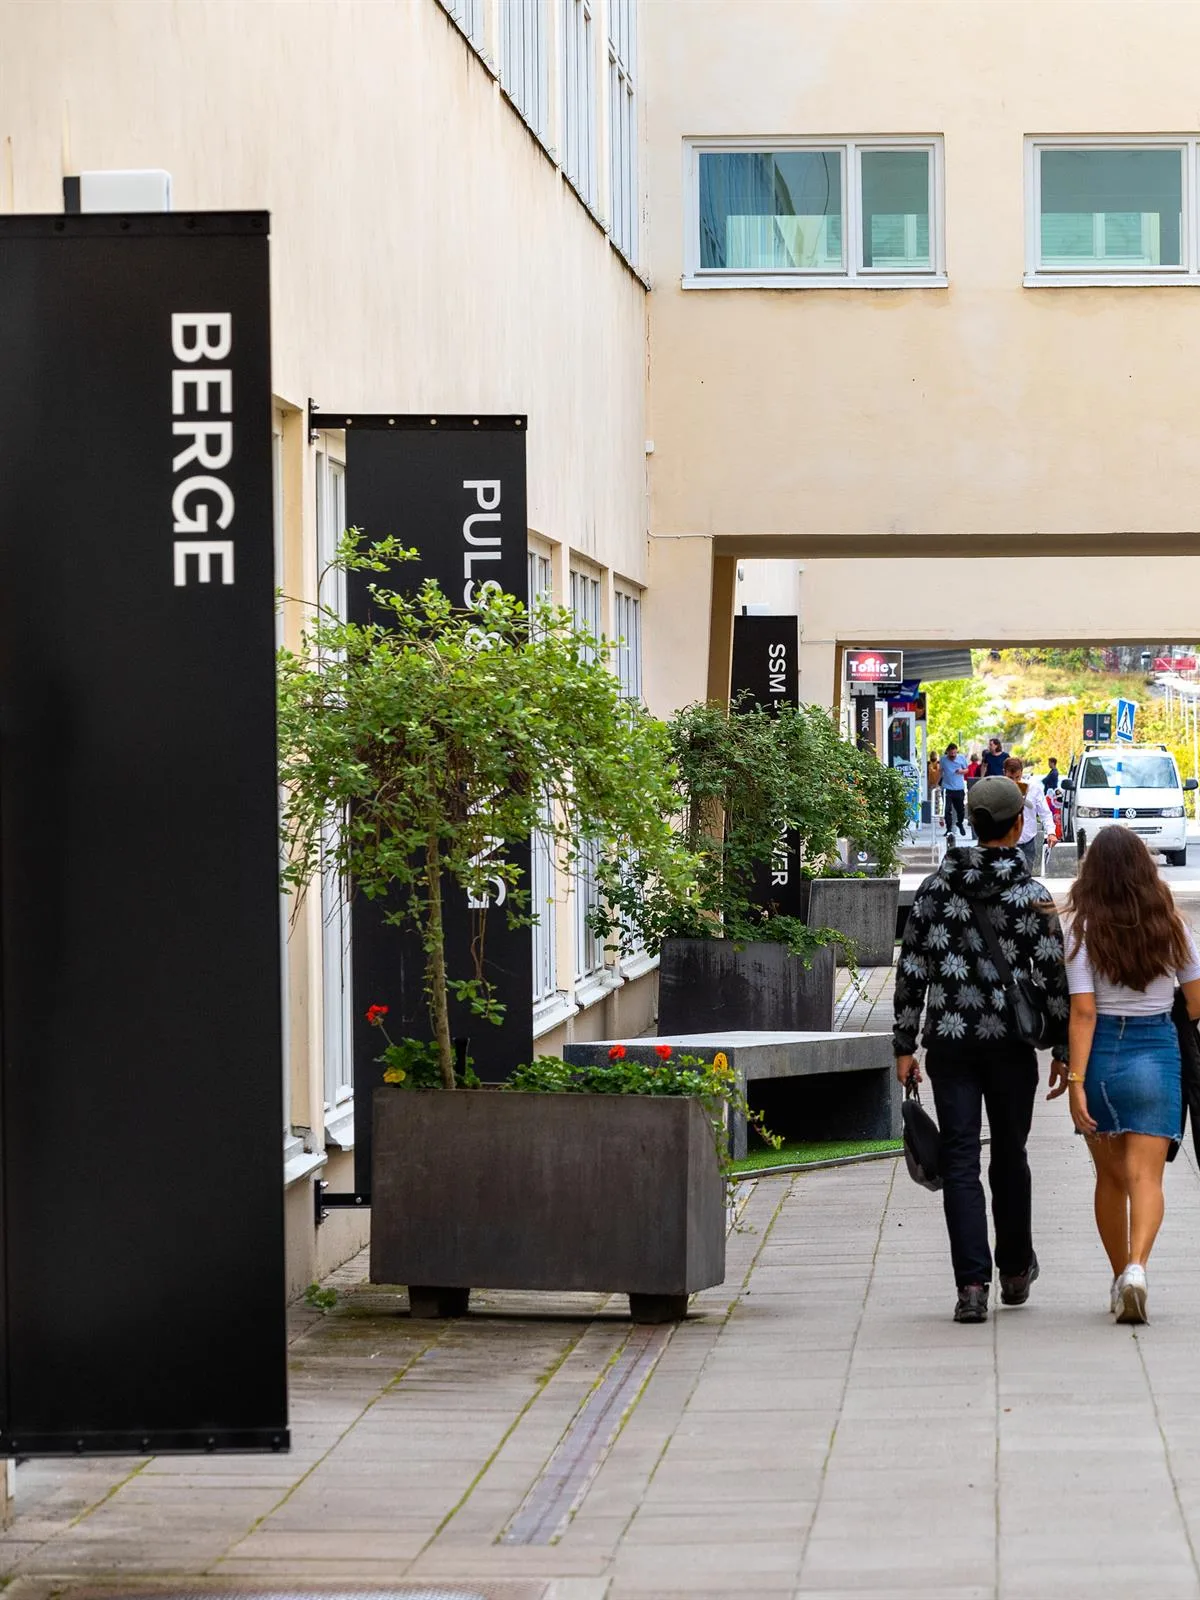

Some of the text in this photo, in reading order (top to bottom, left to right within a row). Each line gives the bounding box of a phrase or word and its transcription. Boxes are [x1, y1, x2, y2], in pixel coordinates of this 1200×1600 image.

[171, 312, 235, 587] BERGE
[463, 479, 502, 610] PULS
[768, 643, 786, 693] SSM
[849, 660, 889, 673] Tonic
[861, 707, 869, 732] TONIC
